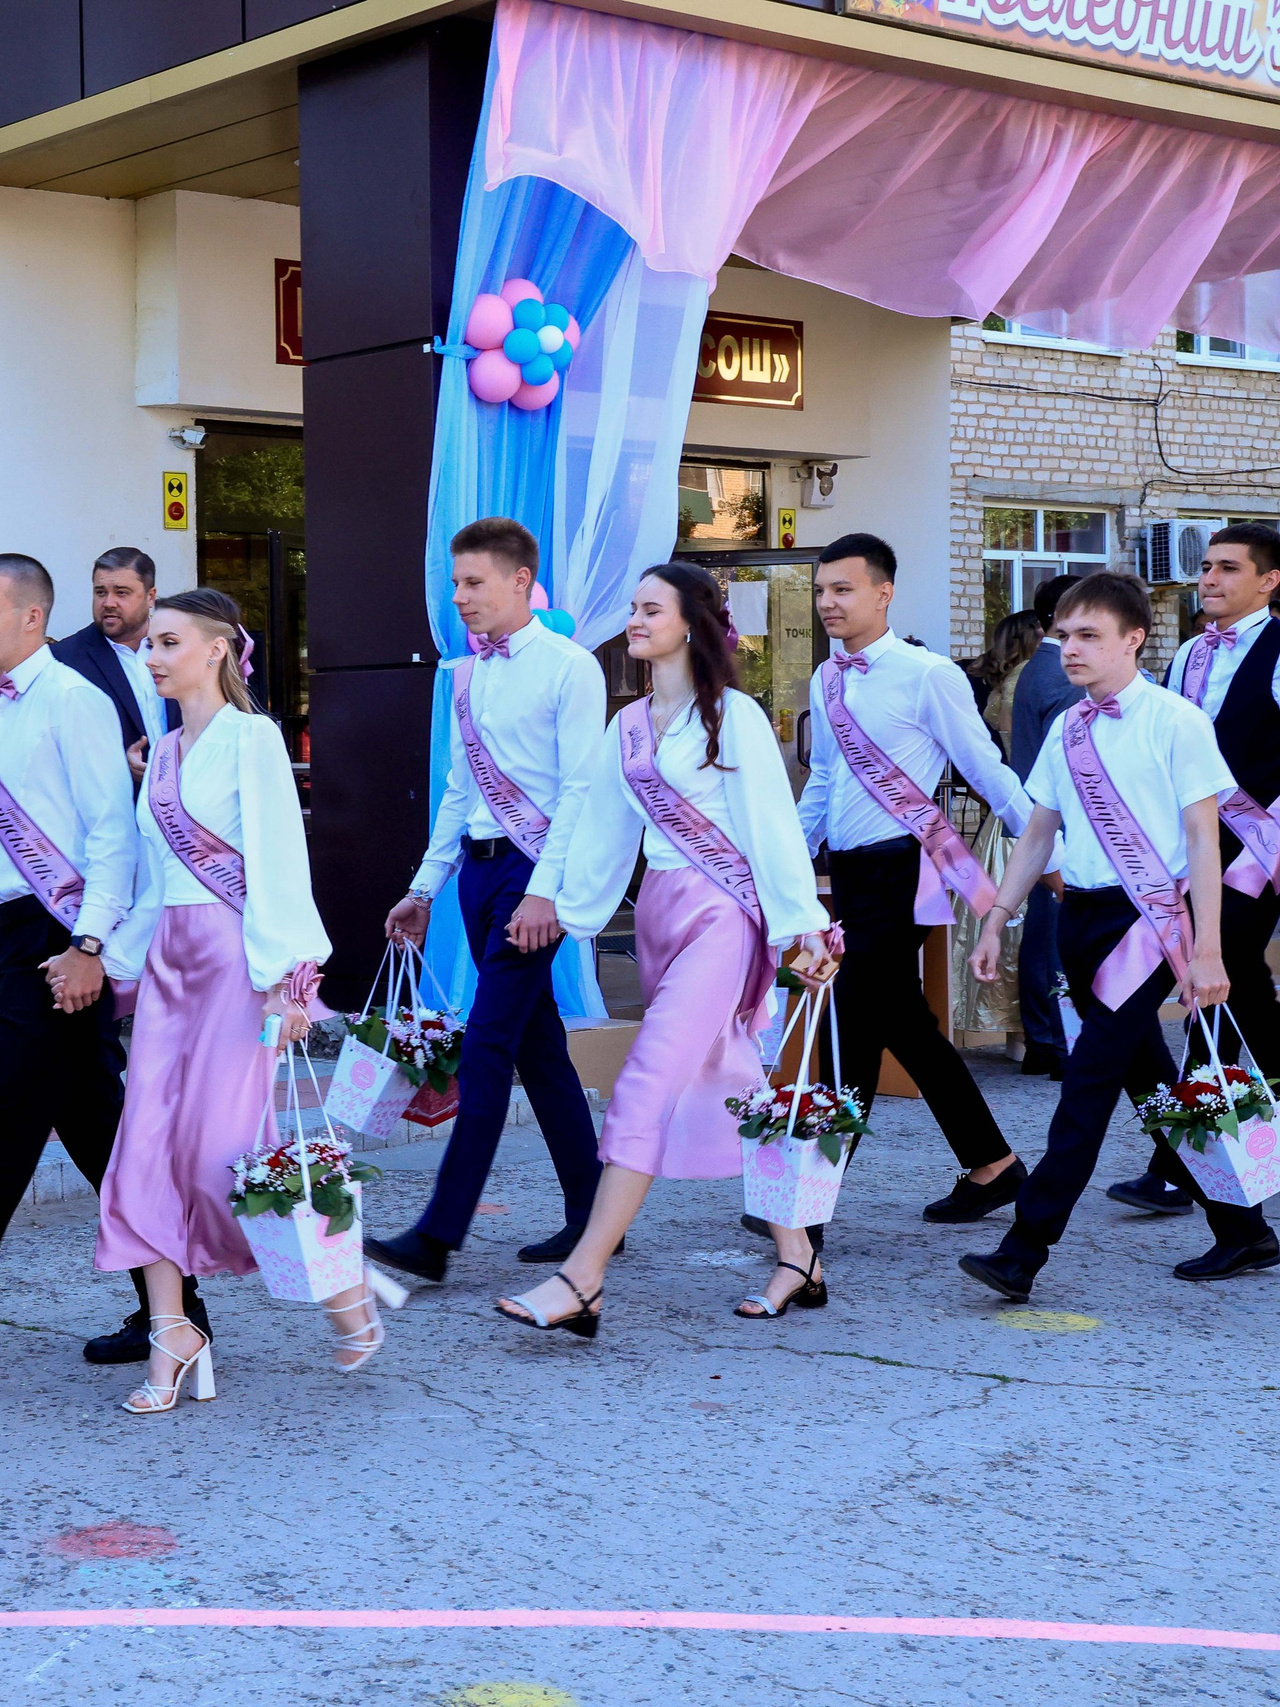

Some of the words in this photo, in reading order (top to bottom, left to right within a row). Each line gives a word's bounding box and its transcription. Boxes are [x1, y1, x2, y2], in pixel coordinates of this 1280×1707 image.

[698, 332, 790, 384] СОШ»
[785, 628, 812, 639] ТОЧК
[467, 742, 530, 829] Выпускник
[638, 777, 734, 873] Выпускница
[836, 722, 910, 806] Выпускник
[902, 803, 946, 840] 2024
[1078, 769, 1149, 879] Выпускник
[1136, 878, 1186, 920] 2024
